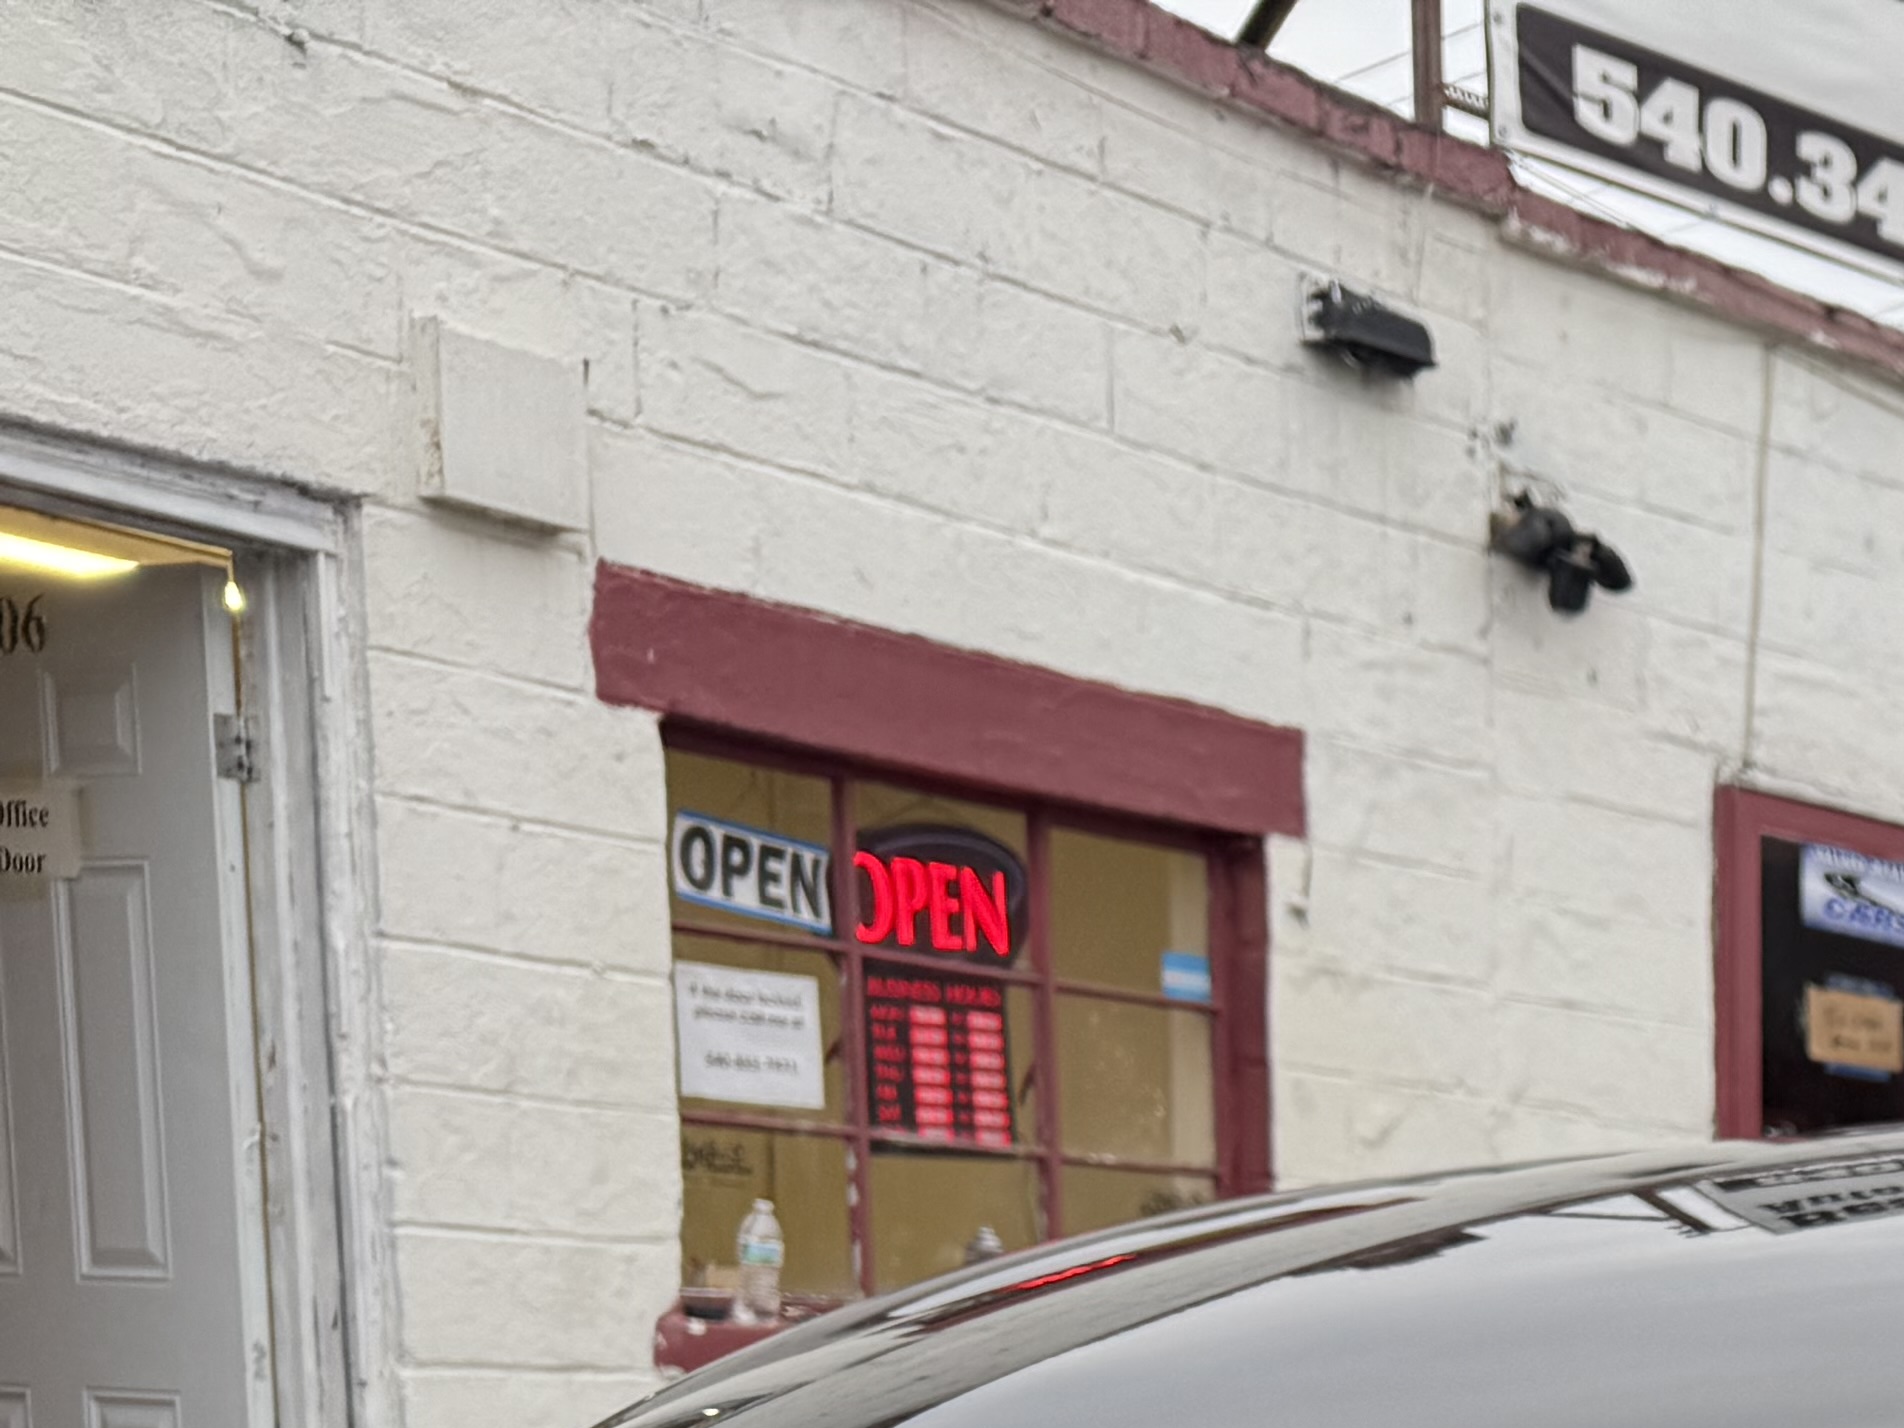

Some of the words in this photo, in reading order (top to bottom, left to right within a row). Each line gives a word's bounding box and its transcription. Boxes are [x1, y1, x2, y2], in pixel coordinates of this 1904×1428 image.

[0, 799, 49, 828] ffice
[680, 825, 824, 920] OPEN
[853, 850, 1010, 958] OPEN
